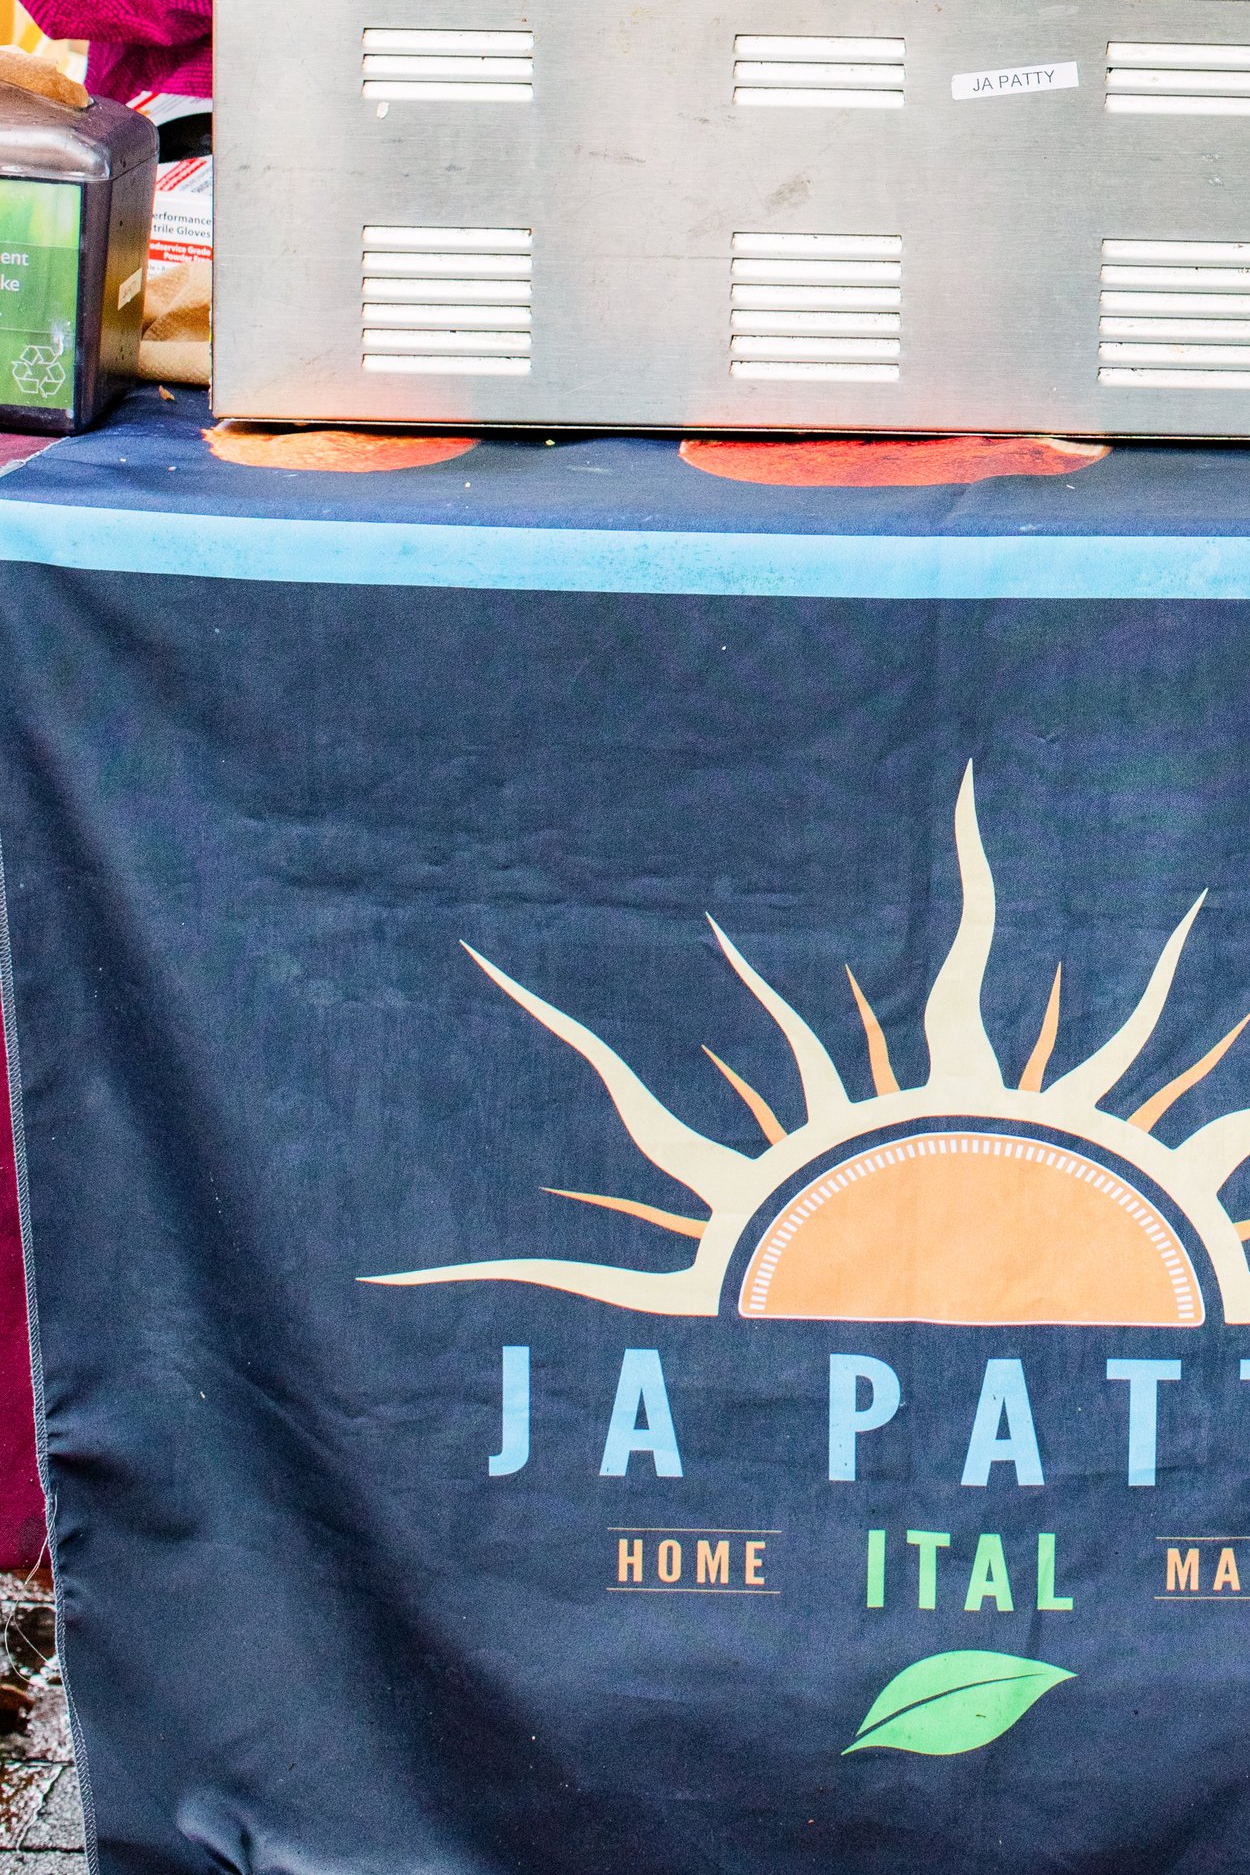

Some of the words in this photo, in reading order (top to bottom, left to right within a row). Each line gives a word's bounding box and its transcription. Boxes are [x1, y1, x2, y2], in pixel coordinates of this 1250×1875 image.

[972, 77, 993, 93] JA
[998, 69, 1056, 89] PATTY
[152, 211, 212, 225] erformance
[153, 223, 174, 235] trile
[176, 225, 211, 238] Gloves
[187, 245, 211, 256] Grade
[0, 252, 29, 266] ent
[0, 273, 20, 291] ke
[488, 1345, 684, 1478] JA
[617, 1538, 767, 1586] HOME
[866, 1529, 1074, 1612] ITAL
